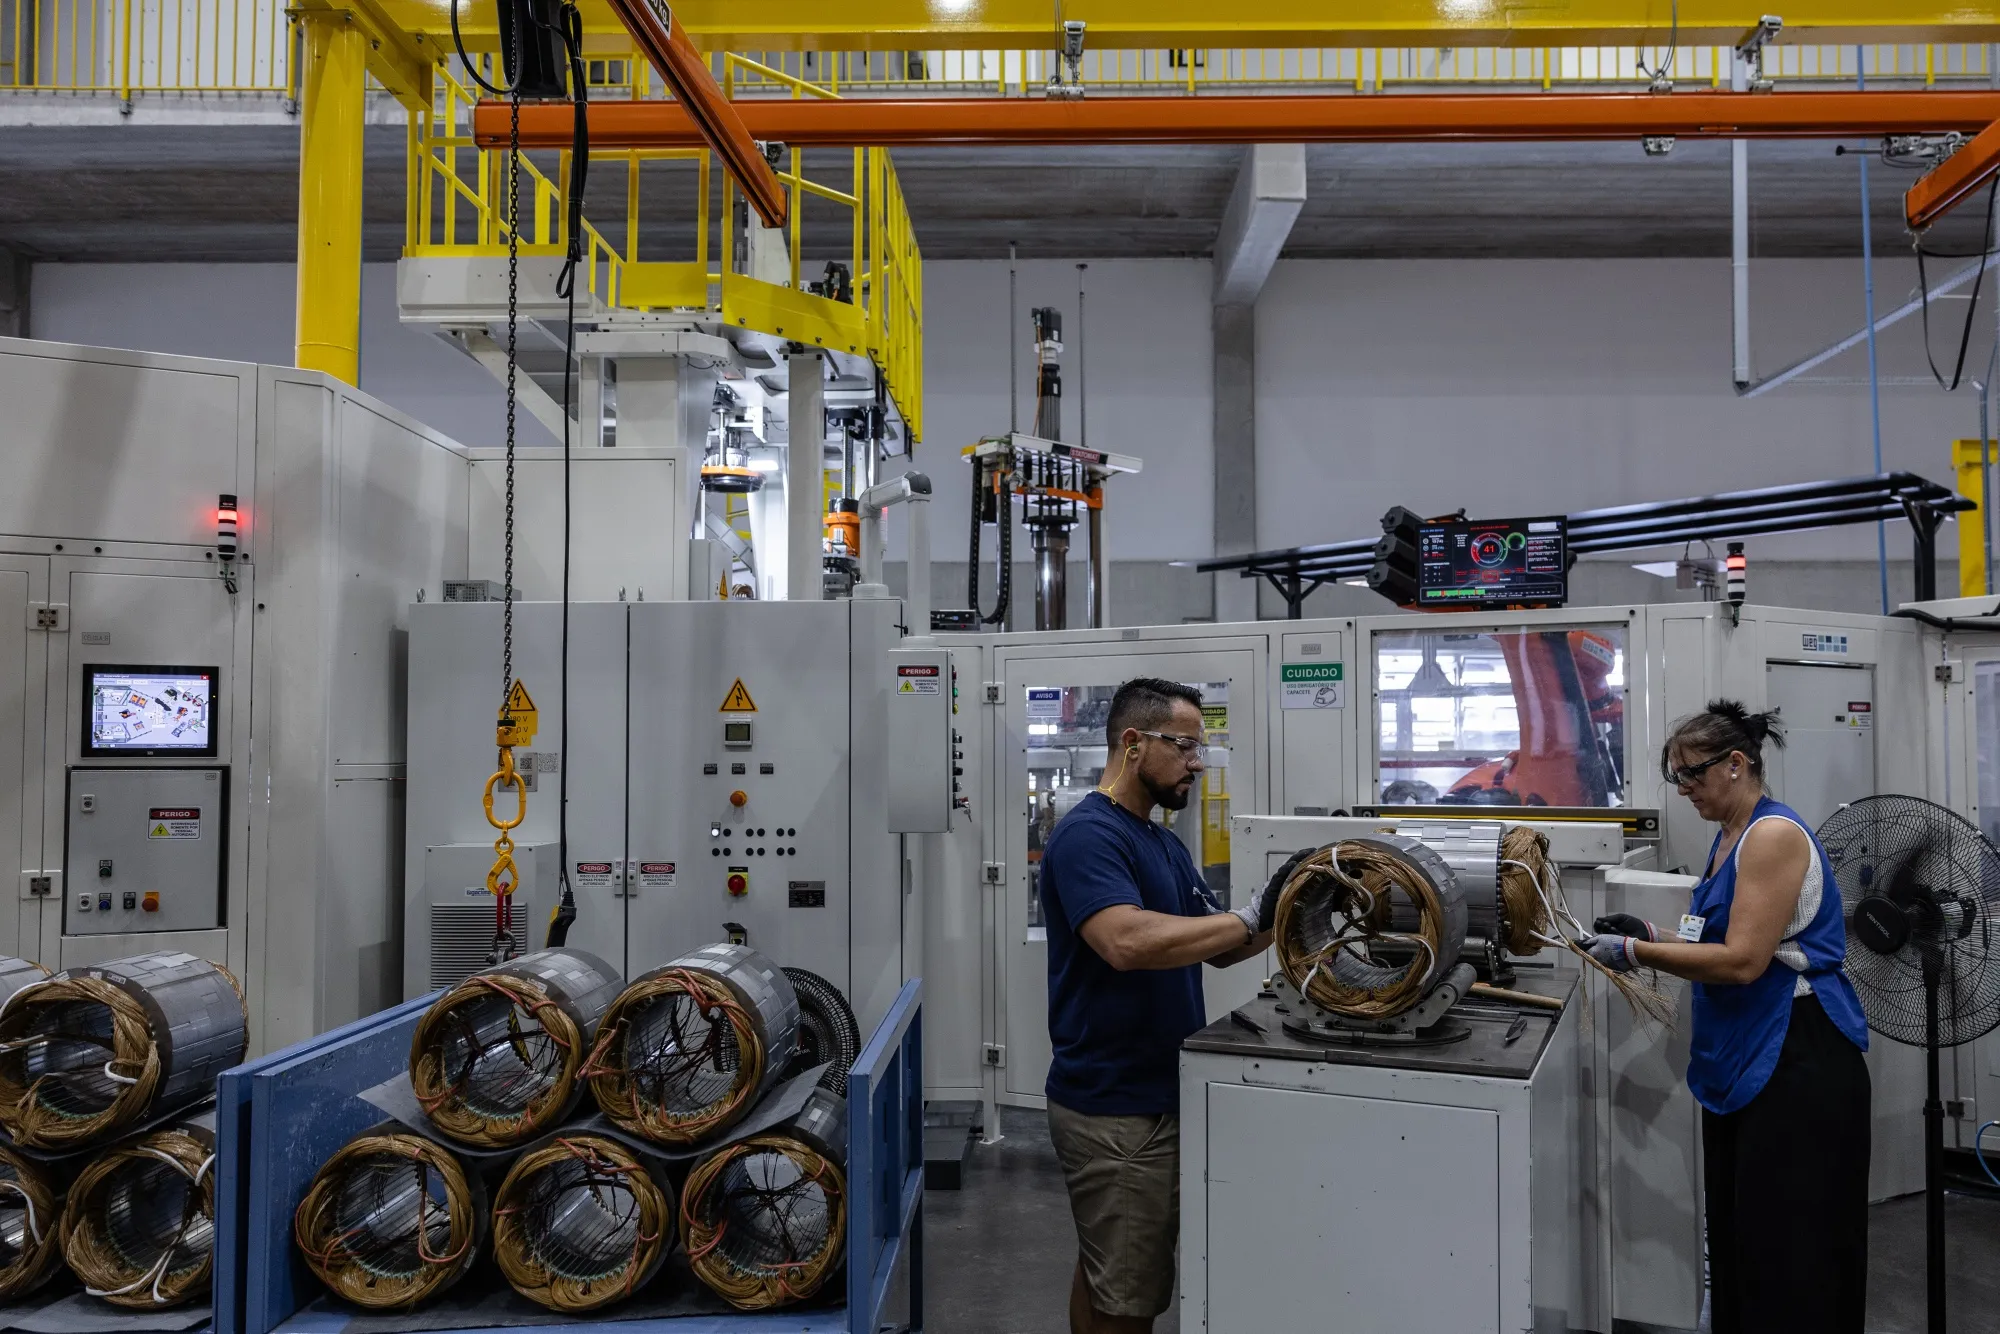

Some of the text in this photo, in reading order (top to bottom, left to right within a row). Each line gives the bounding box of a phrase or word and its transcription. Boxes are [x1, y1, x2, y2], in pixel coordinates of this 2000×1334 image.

[1483, 545, 1494, 553] 41
[1286, 667, 1338, 678] CUIDADO
[1866, 911, 1890, 939] VENTISOL
